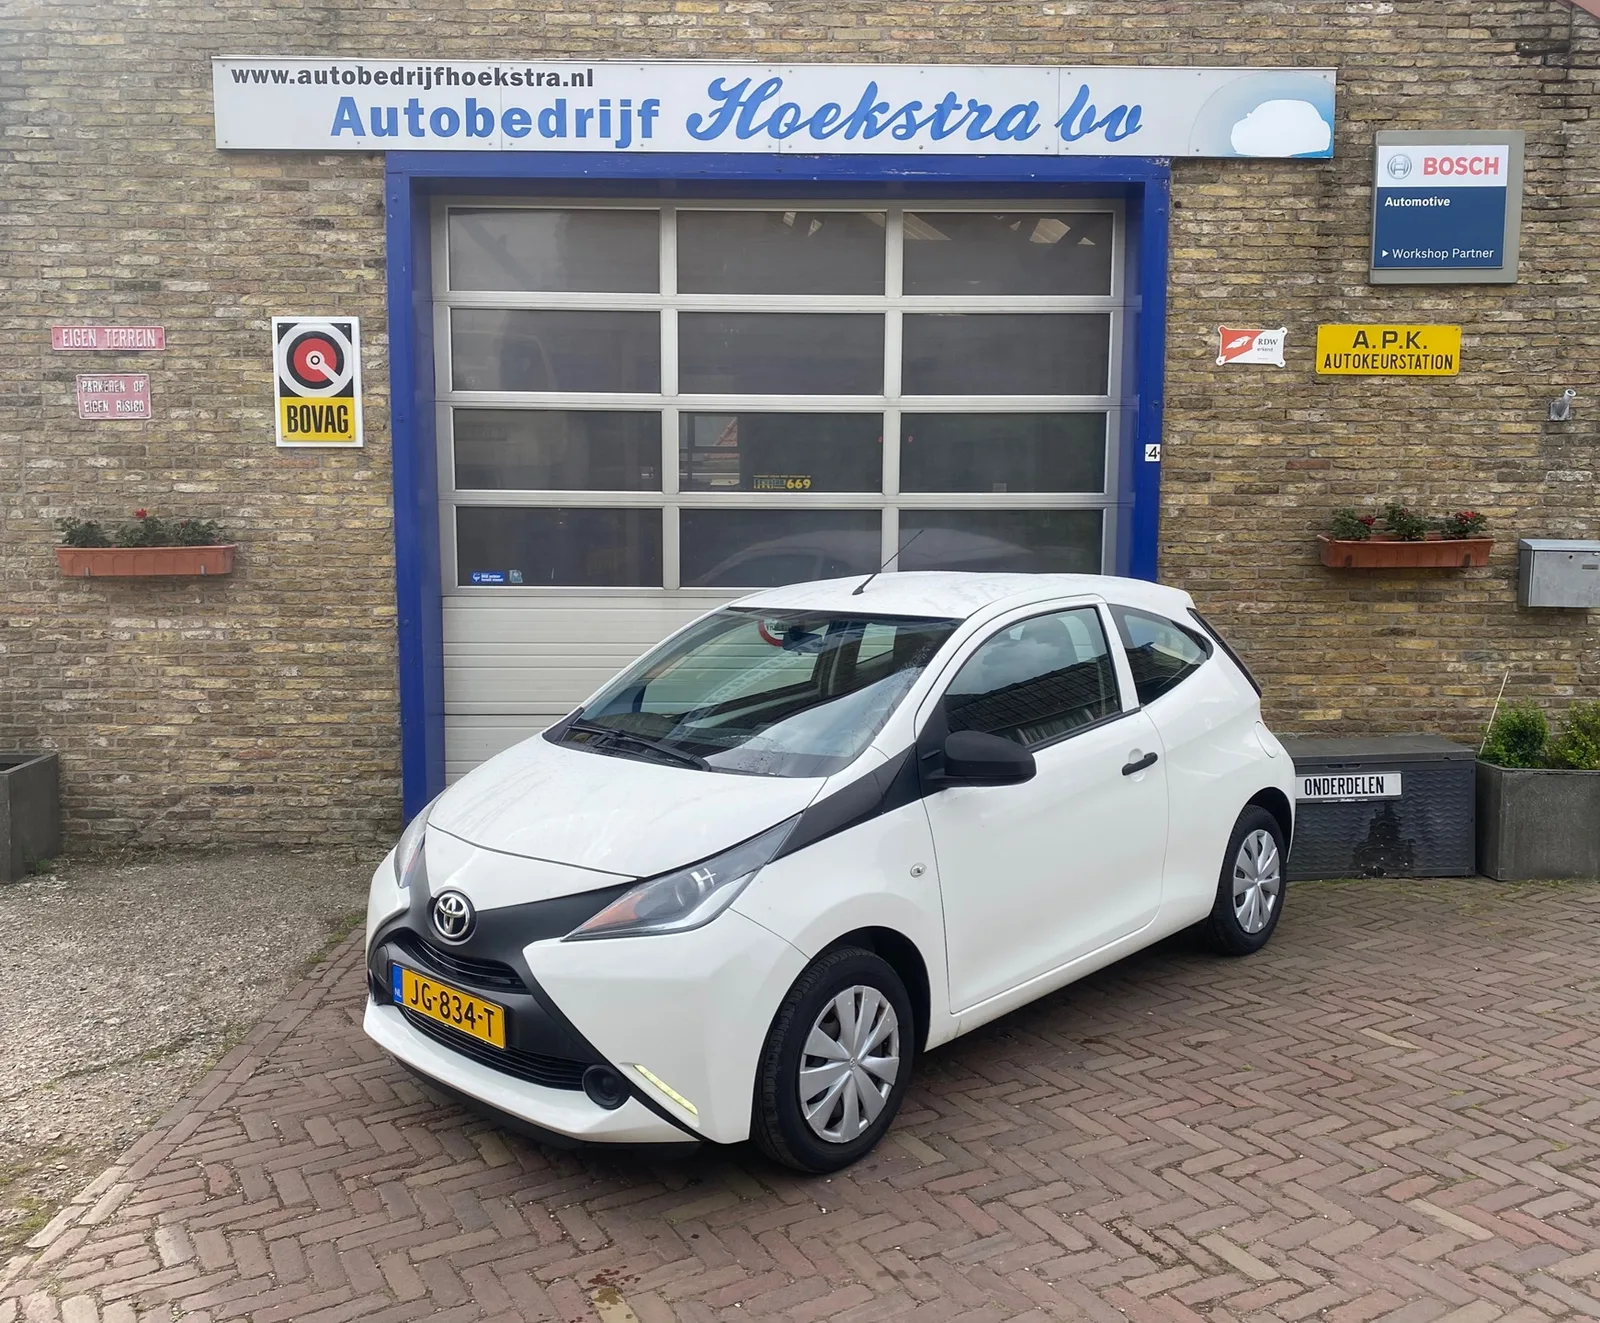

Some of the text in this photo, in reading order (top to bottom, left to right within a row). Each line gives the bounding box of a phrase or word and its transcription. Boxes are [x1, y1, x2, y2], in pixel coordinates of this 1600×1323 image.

[231, 66, 594, 90] www.autobedrijfhoekstra.nl
[330, 76, 1142, 149] Autobedrijf Hoekstra bv
[1423, 156, 1500, 176] BOSCH
[1384, 196, 1451, 207] Automotive
[1392, 247, 1495, 261] Workshop Partner
[62, 328, 156, 347] EIGEN TERREIN
[1257, 338, 1279, 346] RDW
[1352, 330, 1428, 350] A.P.K.
[1323, 353, 1454, 370] AUTOKEURSTATION
[82, 380, 145, 393] PARKEREN OP
[83, 400, 145, 413] EIGEN RISICO
[286, 404, 349, 434] BOVAG
[1147, 445, 1158, 460] 4
[1304, 776, 1385, 796] ONDERDELEN
[394, 987, 402, 998] NL
[410, 979, 495, 1039] JG-834-T
